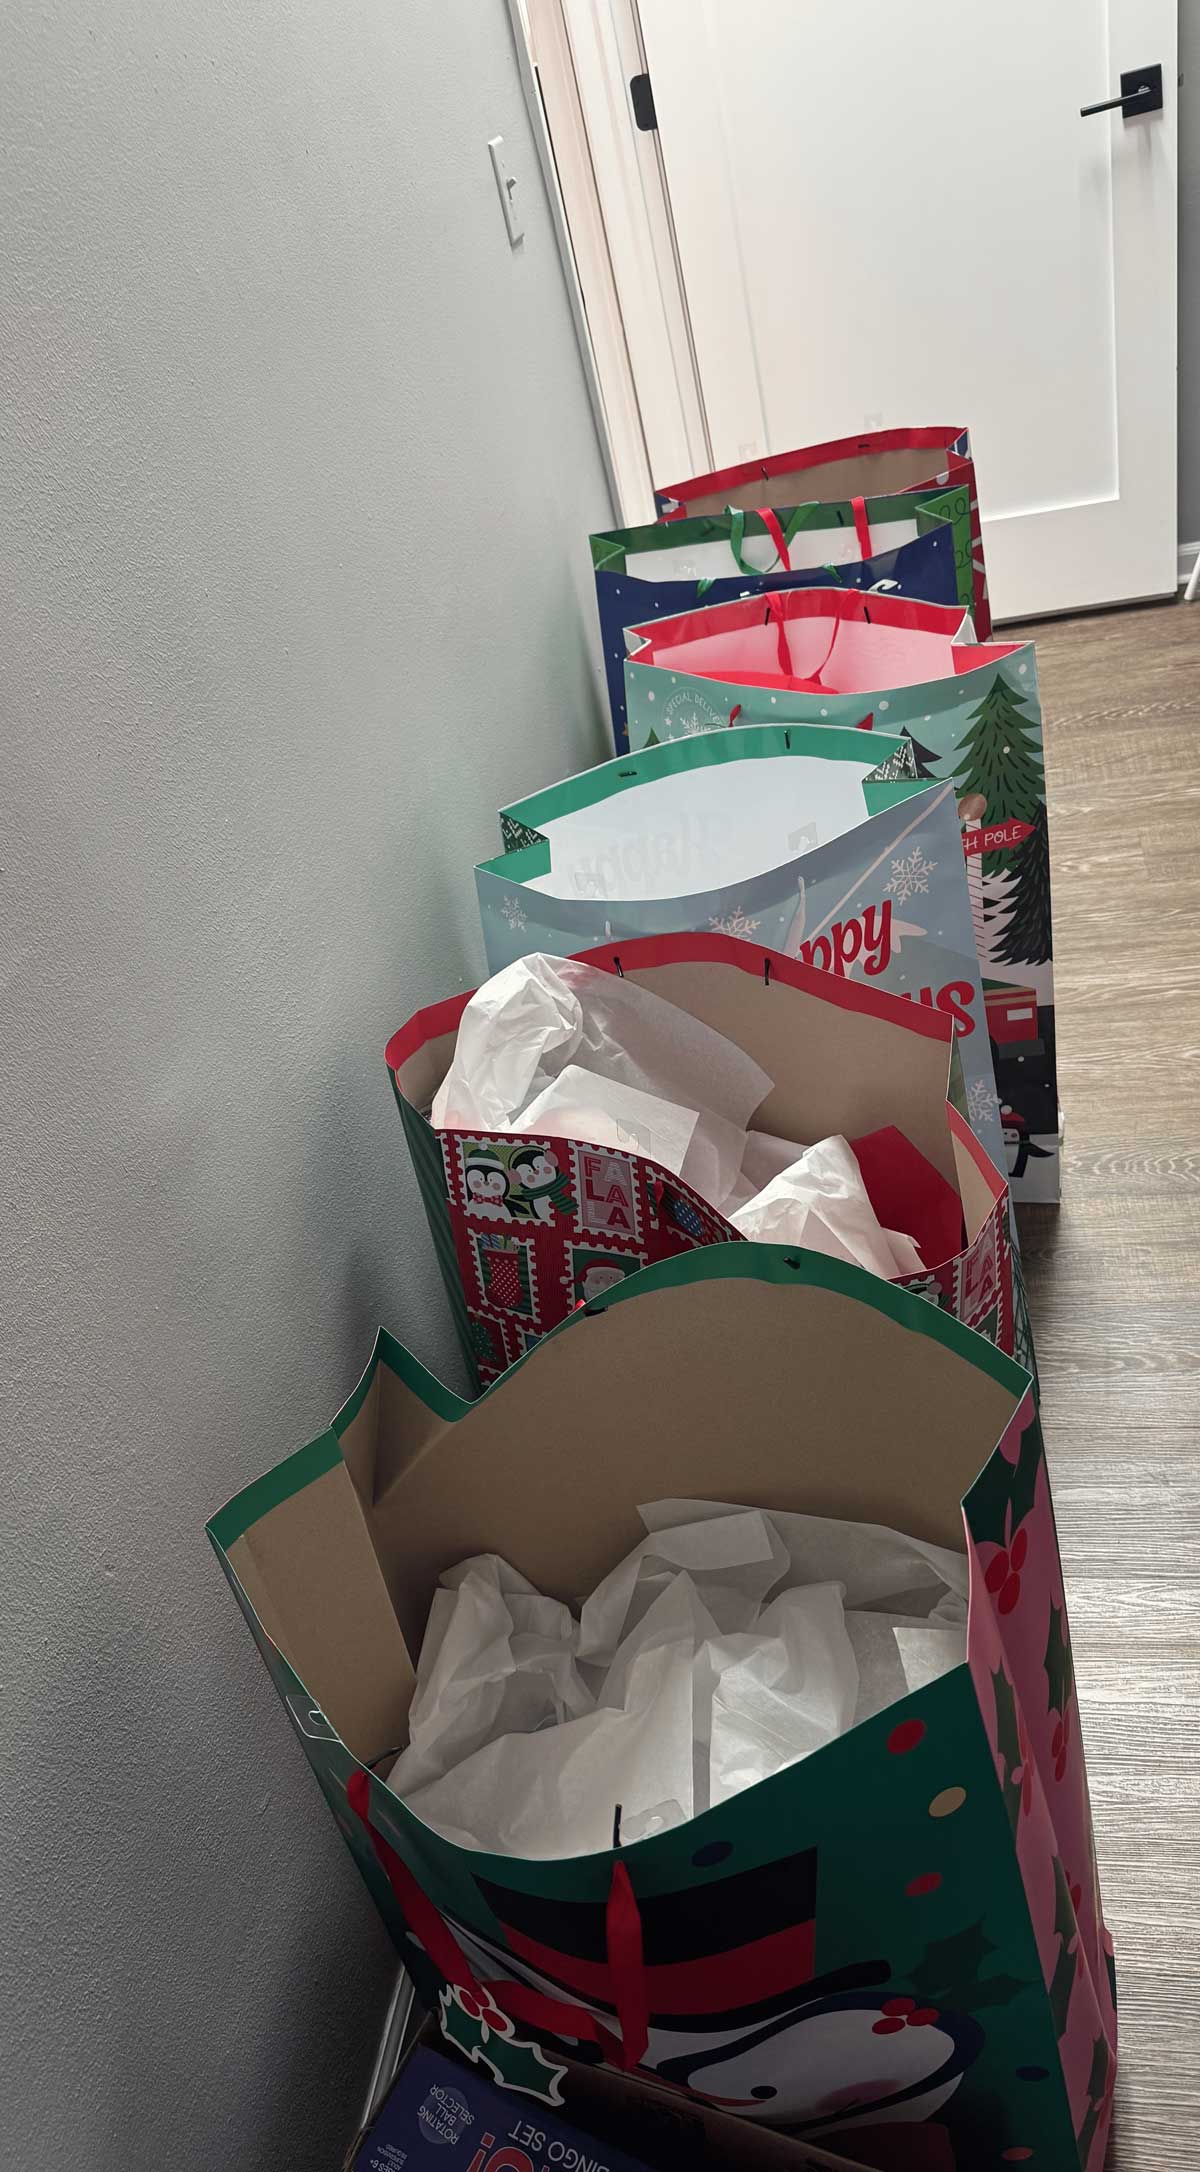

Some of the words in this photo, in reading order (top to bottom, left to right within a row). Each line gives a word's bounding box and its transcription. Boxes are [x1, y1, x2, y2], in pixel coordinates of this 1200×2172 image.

[984, 825, 1022, 847] POLE
[800, 900, 892, 977] ppy
[429, 2083, 475, 2125] SELECTOR
[435, 2102, 457, 2126] BALL
[417, 2105, 460, 2145] ROTATING
[507, 2120, 546, 2152] SET
